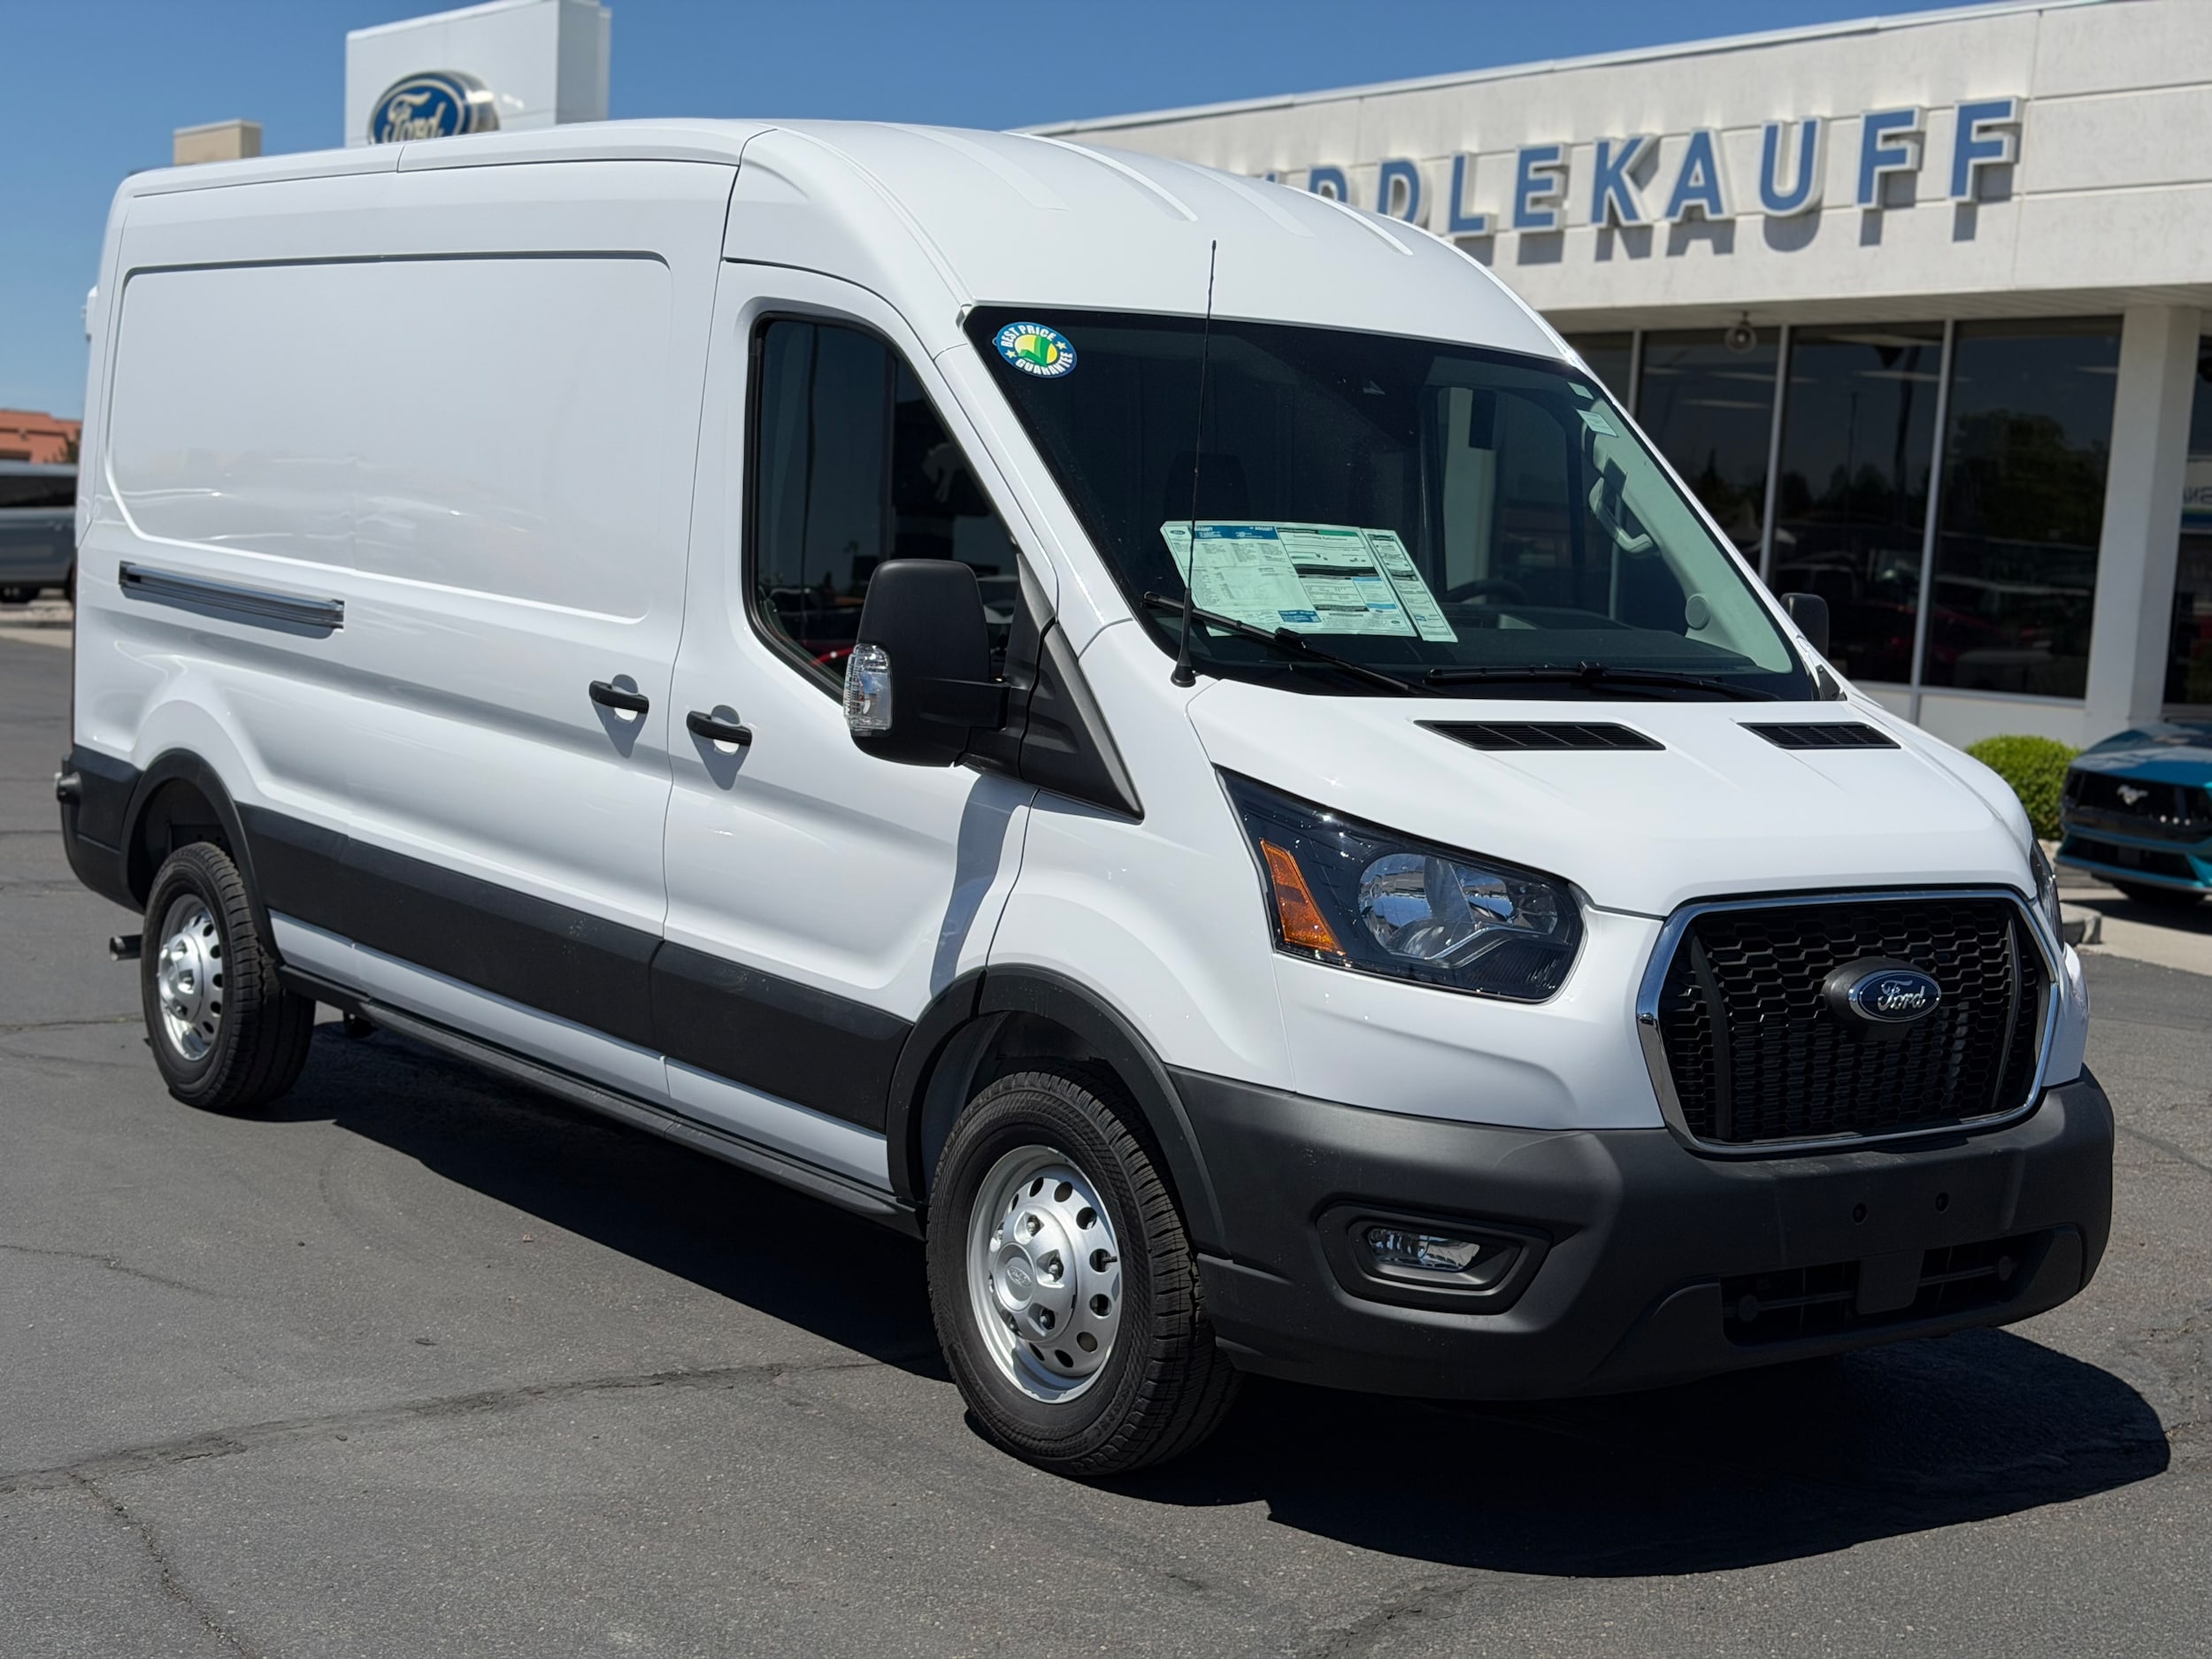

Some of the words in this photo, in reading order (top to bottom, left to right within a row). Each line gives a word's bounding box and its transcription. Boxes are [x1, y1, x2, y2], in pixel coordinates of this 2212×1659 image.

[383, 91, 446, 142] Ford
[1001, 326, 1020, 348] BEST
[1018, 324, 1057, 342] PRICE
[1015, 351, 1073, 376] GUARANTEE
[1878, 979, 1926, 1011] Ford
